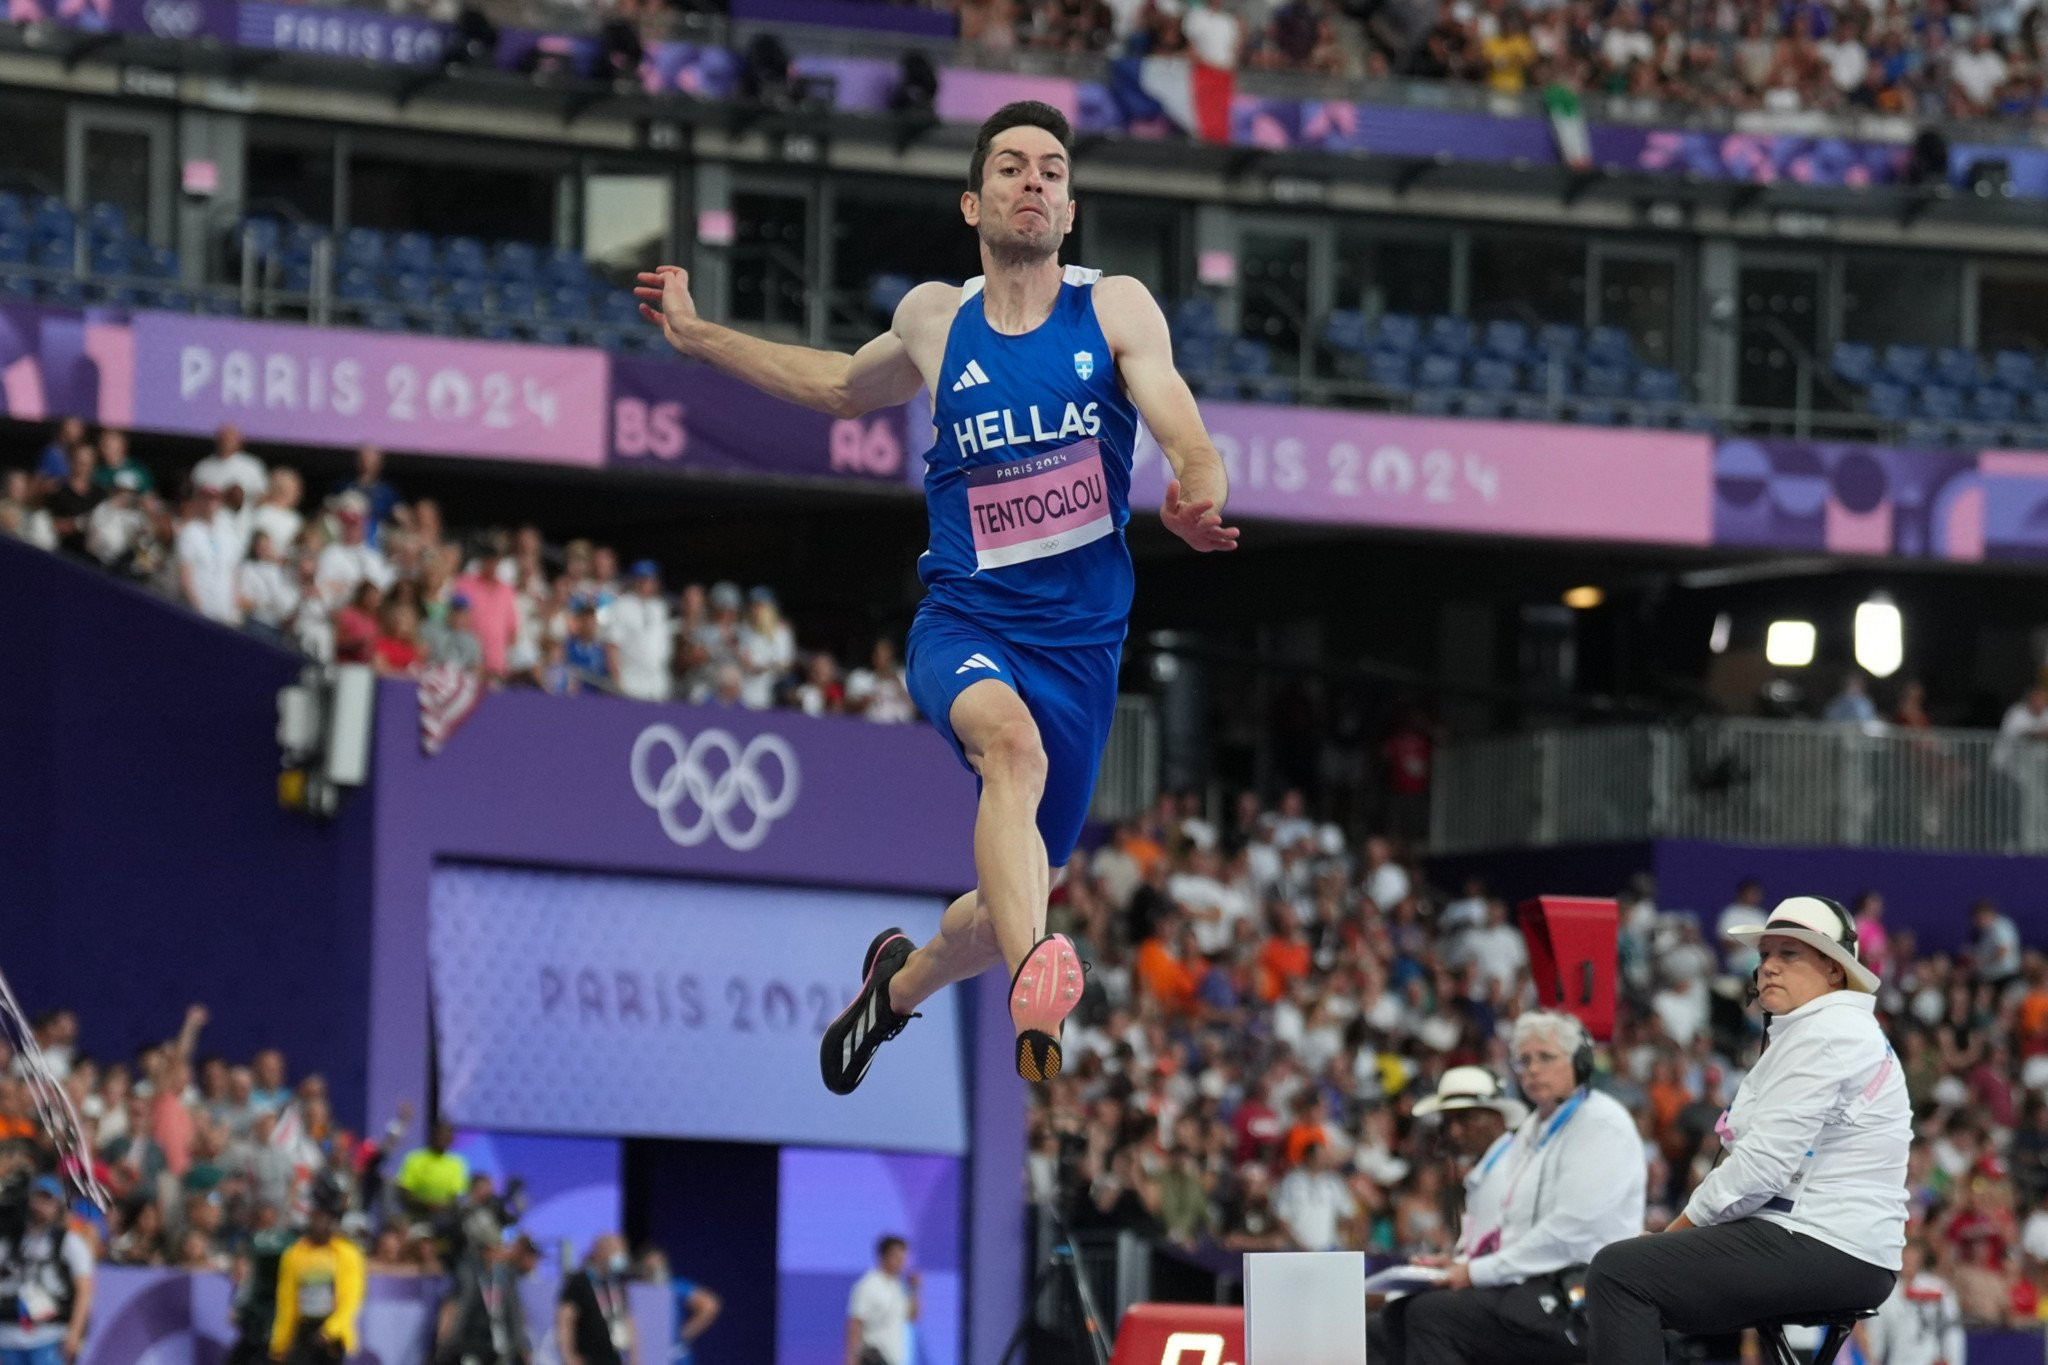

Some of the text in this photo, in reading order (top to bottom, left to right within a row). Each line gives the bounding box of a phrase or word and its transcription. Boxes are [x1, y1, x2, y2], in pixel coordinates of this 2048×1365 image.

[273, 13, 443, 64] PARIS 20
[179, 345, 557, 428] PARIS 2024
[953, 401, 1101, 458] HELLAS
[996, 454, 1067, 479] PARIS 2024
[1327, 440, 1498, 502] 2024
[973, 473, 1102, 535] TENTOGLOU
[538, 963, 852, 1035] PARIS 202
